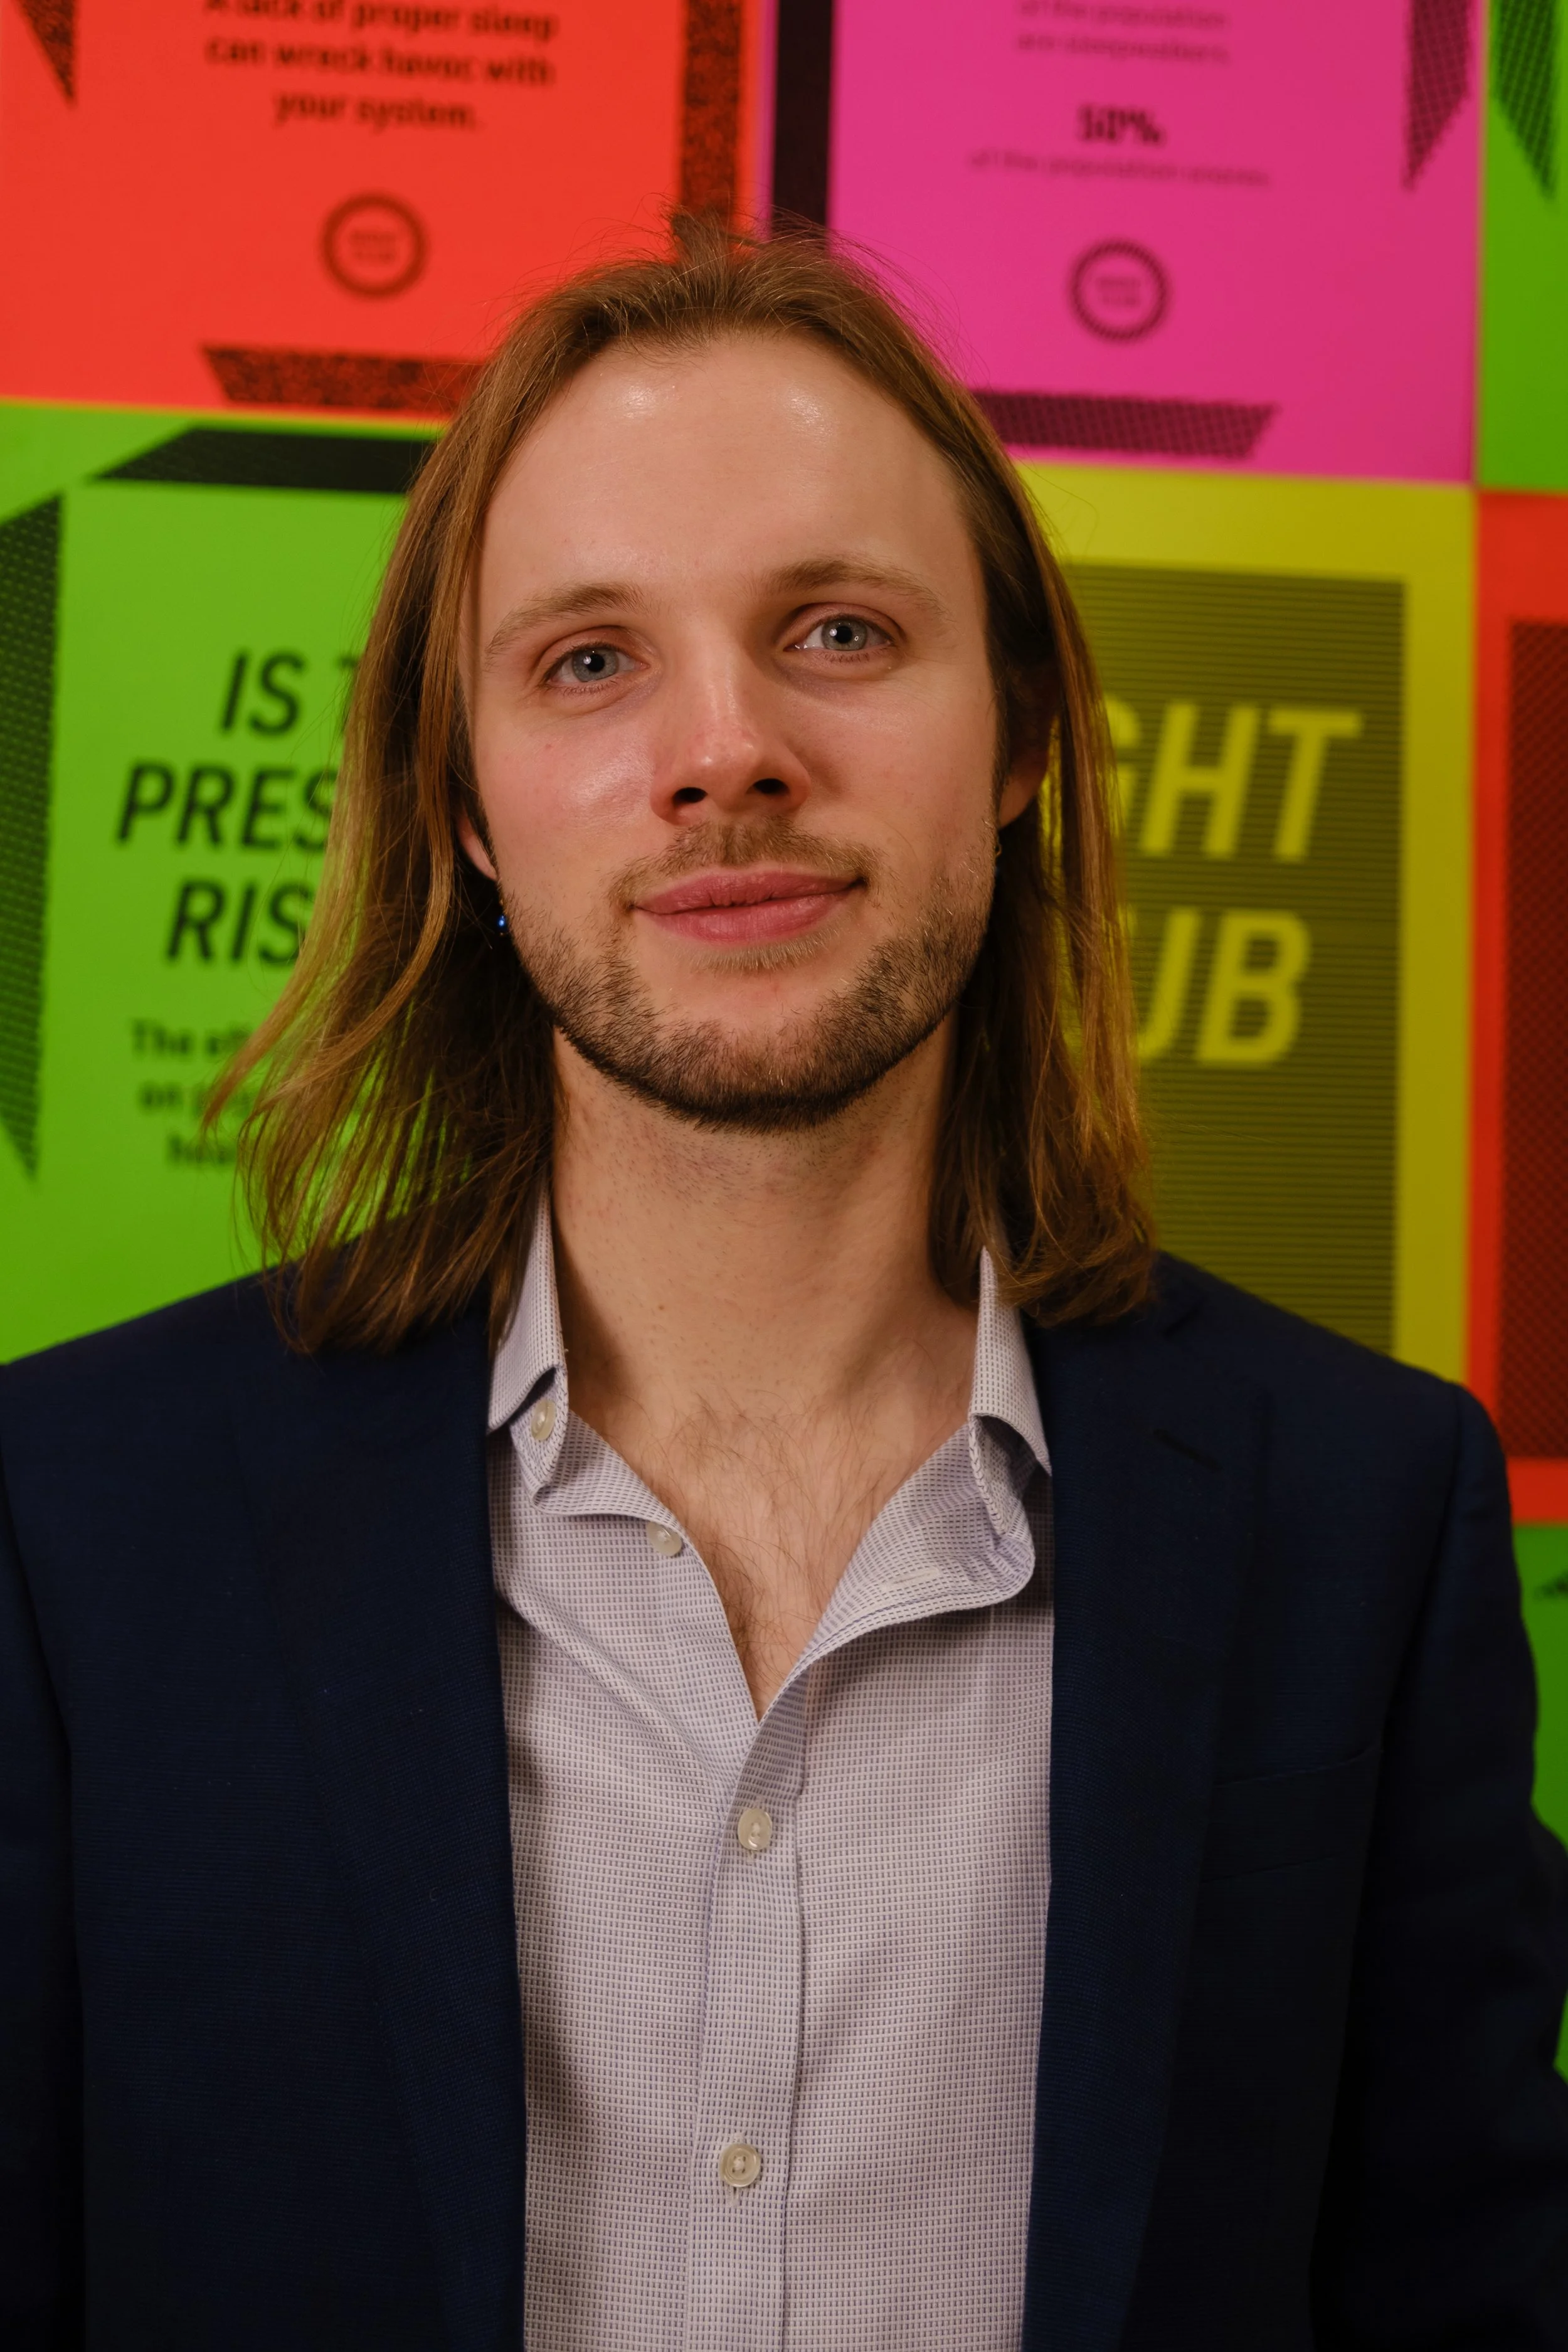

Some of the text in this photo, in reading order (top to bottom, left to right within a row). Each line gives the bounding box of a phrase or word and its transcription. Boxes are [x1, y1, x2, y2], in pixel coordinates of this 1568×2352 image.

[312, 0, 346, 20] of
[352, 3, 461, 34] proper
[468, 6, 559, 44] sleep
[205, 37, 556, 87] can wreck havoc with
[273, 92, 347, 129] your
[220, 650, 305, 737] IS
[132, 1017, 195, 1061] The
